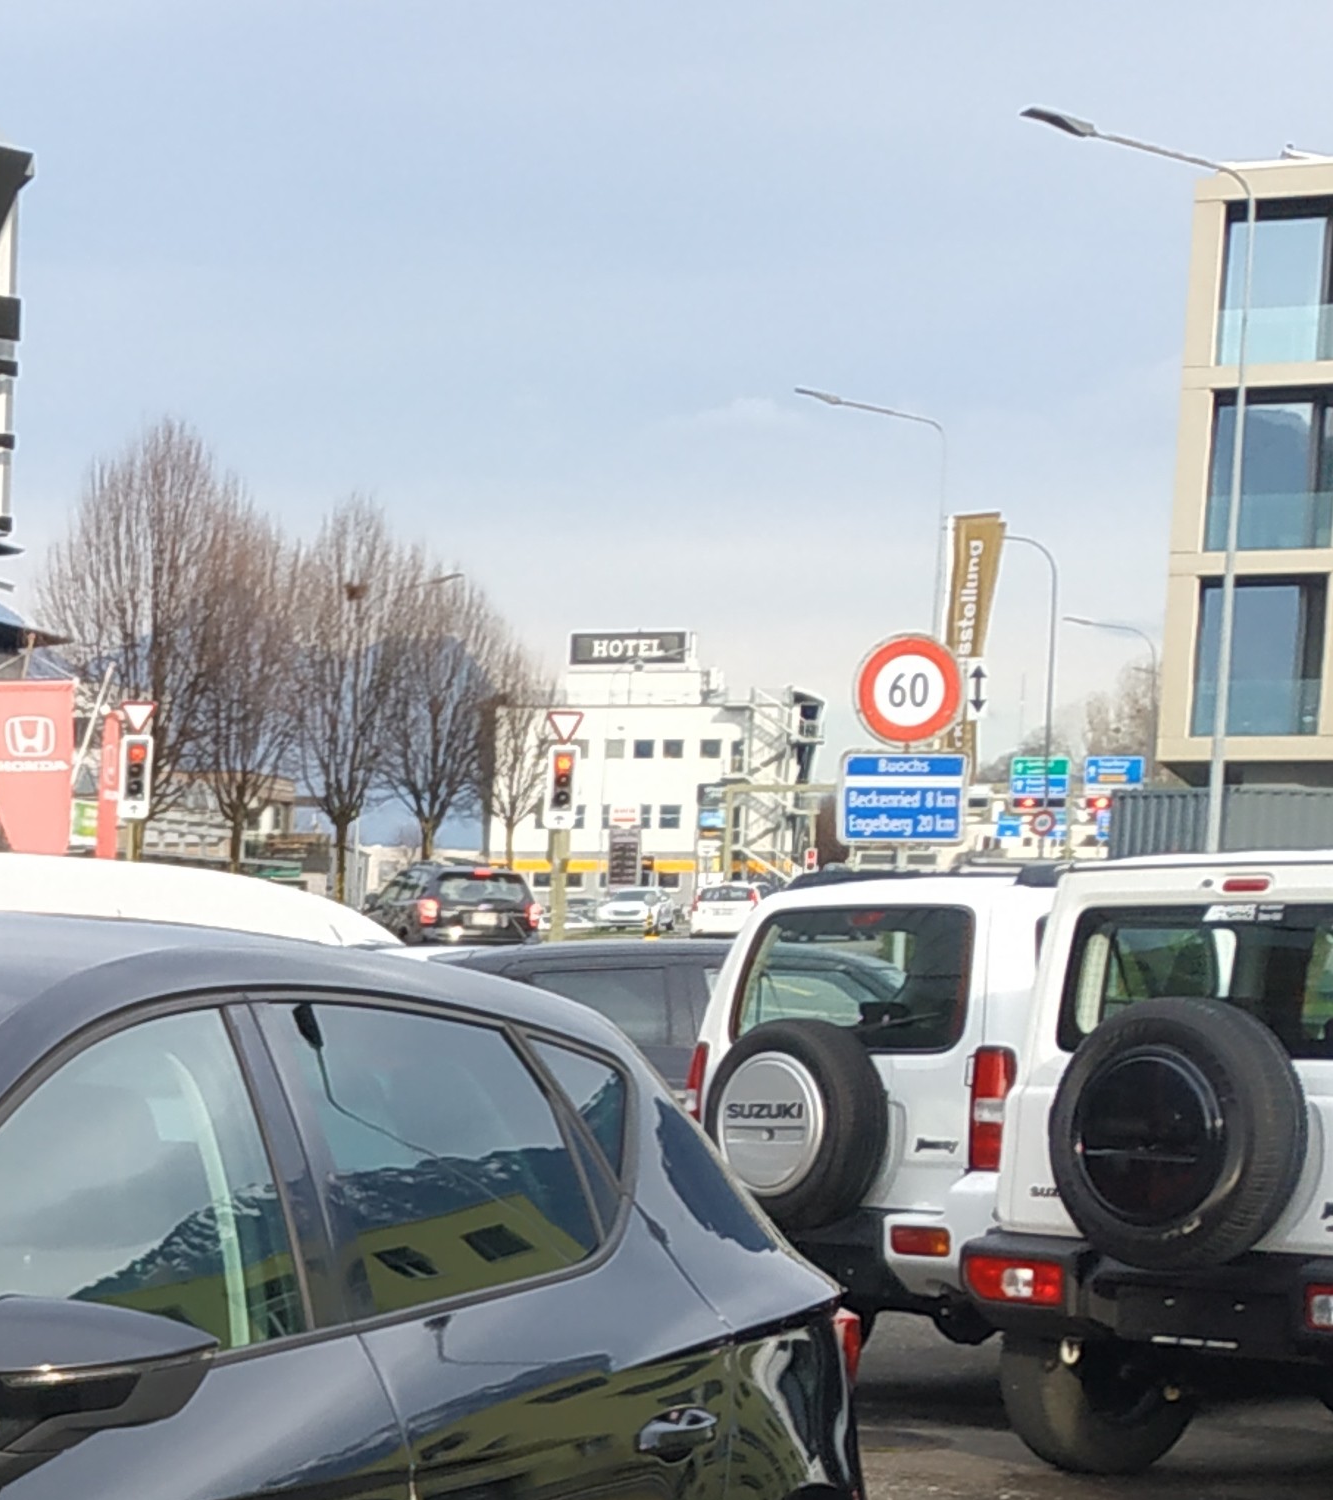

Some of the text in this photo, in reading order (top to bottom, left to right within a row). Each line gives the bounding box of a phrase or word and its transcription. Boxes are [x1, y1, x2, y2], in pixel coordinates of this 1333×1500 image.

[592, 638, 666, 658] HOTEL
[888, 672, 930, 708] 60
[877, 758, 932, 773] Buochs
[935, 791, 957, 808] km
[848, 813, 956, 836] Engelberg 20 km
[726, 1102, 804, 1119] SUZUKI
